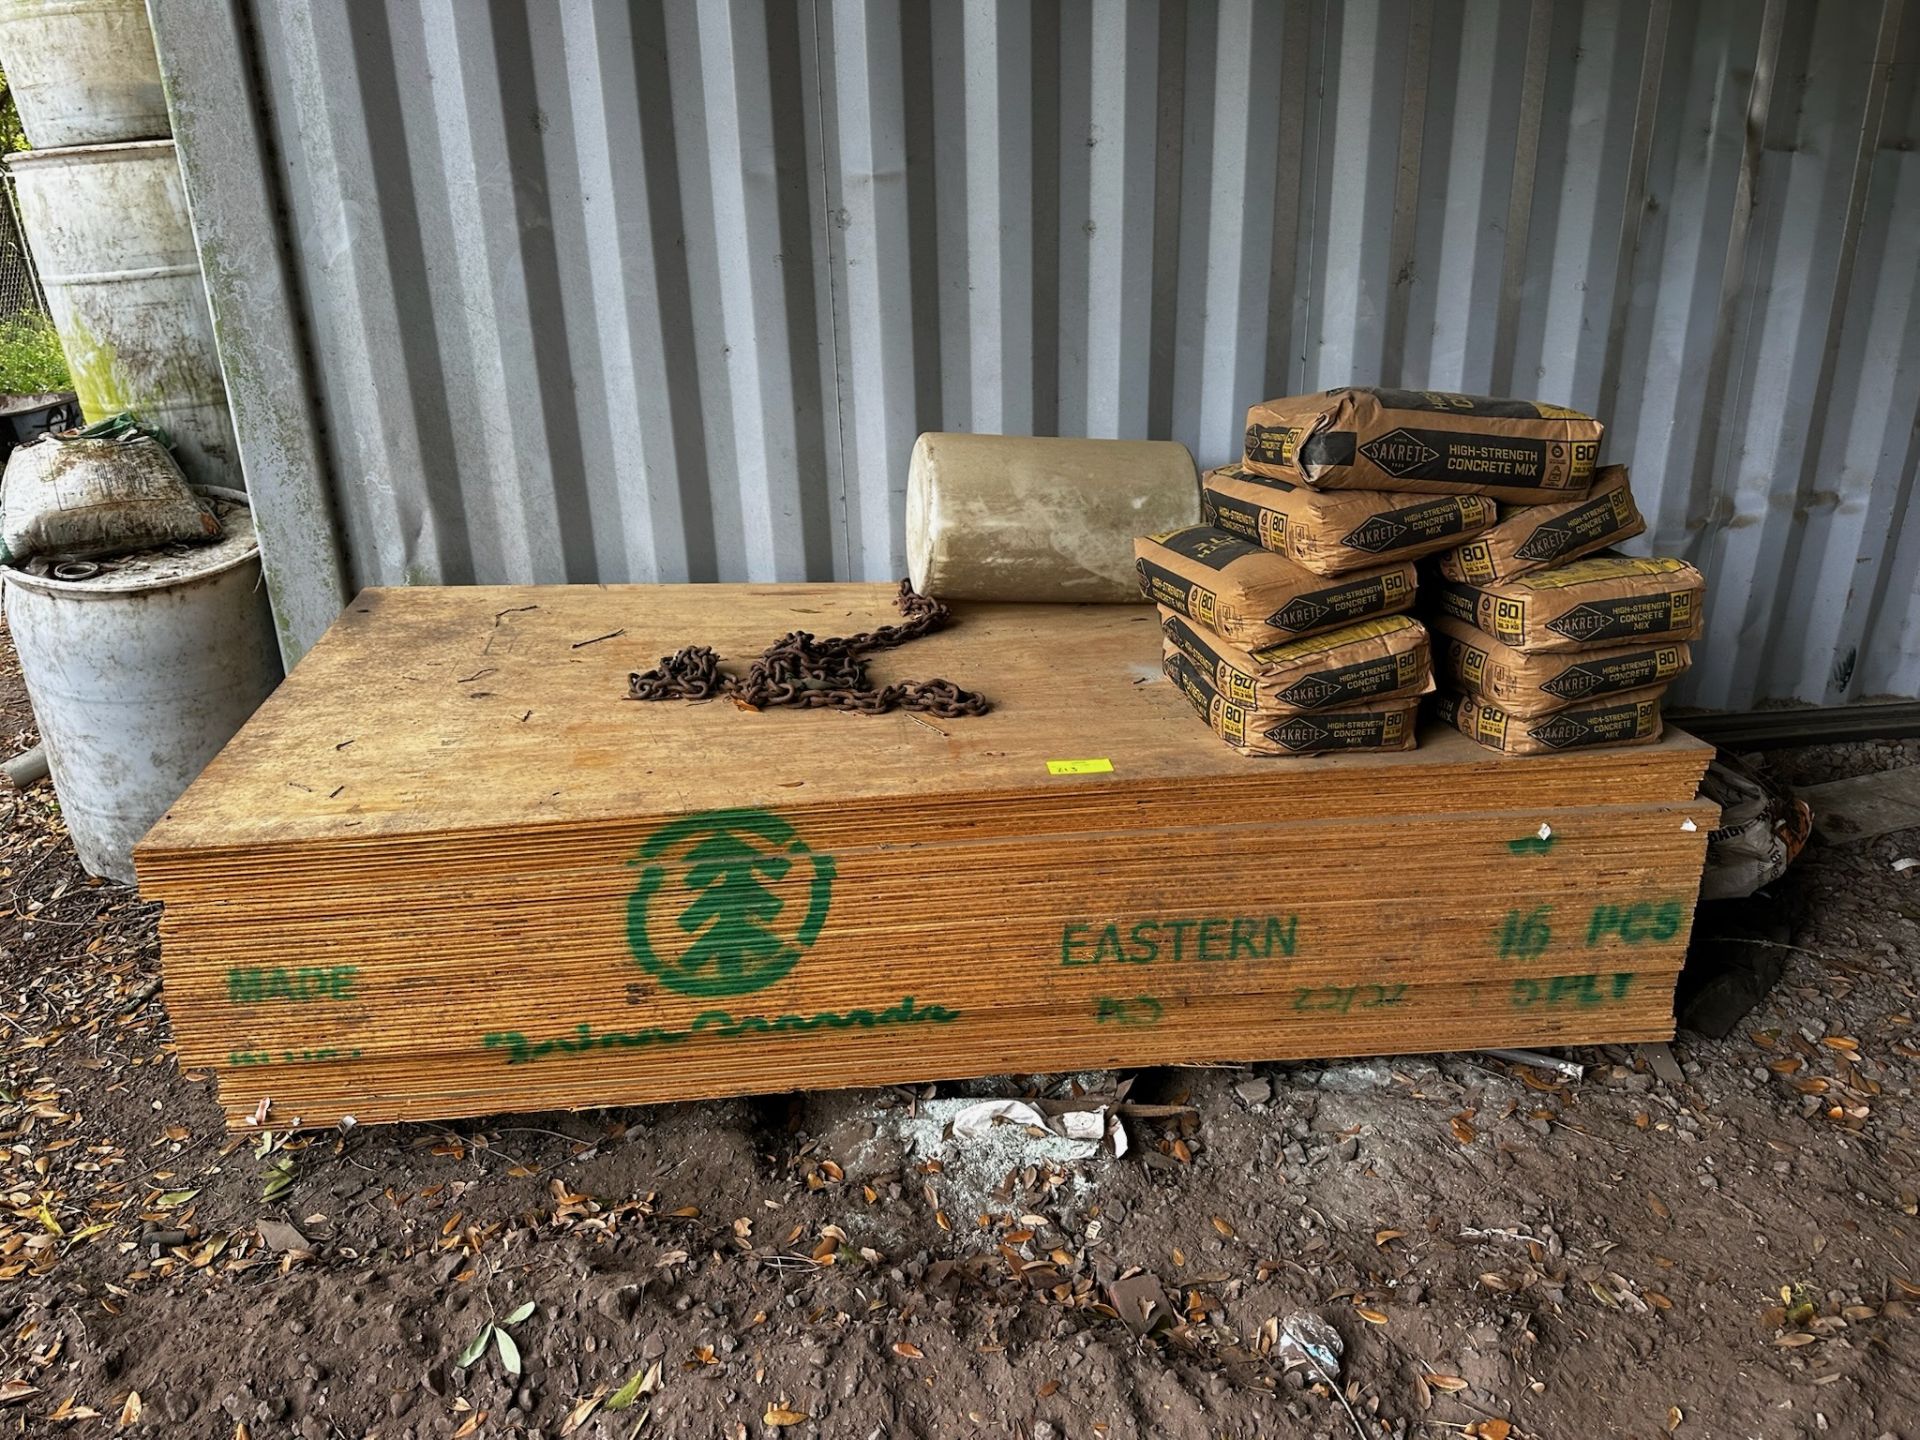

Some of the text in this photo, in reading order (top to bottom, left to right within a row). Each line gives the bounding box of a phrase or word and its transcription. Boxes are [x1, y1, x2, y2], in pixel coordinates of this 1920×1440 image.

[1370, 441, 1430, 463] SAKRETE
[1449, 444, 1538, 462] HIGH-STRENGTH
[1574, 445, 1597, 461] 80
[1447, 457, 1538, 477] CONCRETE MIX
[1460, 495, 1478, 510] 80
[1611, 493, 1625, 507] 80
[1404, 503, 1459, 523] HIGH-STRENGTH
[1568, 502, 1612, 528] HIGH-STRENGTH
[1272, 516, 1285, 533] 80
[1412, 513, 1455, 531] CONCRETE
[1425, 525, 1442, 536] MIX
[1575, 512, 1610, 534] CONCRETE
[1351, 523, 1399, 546] SAKRETE
[1523, 531, 1567, 558] SAKRETE
[1462, 545, 1485, 562] 80
[1384, 576, 1403, 591] 80
[1201, 593, 1213, 611] 80
[1326, 584, 1383, 604] HIGH-STRENGTH
[1335, 594, 1377, 611] CONCRETE
[1673, 593, 1689, 608] 80
[1498, 602, 1519, 620] 80
[1612, 600, 1671, 614] HIGH-STRENGTH
[1275, 605, 1322, 627] SAKRETE
[1555, 614, 1606, 632] SAKRETE
[1619, 610, 1664, 623] CONCRETE
[1633, 622, 1650, 631] MIX
[1399, 653, 1415, 669] 80
[1466, 651, 1483, 669] 80
[1602, 657, 1657, 674] HIGH-STRENGTH
[1658, 650, 1676, 666] 80
[1338, 663, 1396, 683] HIGH-STRENGTH
[1346, 673, 1391, 690] CONCRETE
[1608, 668, 1650, 682] CONCRETE
[1233, 674, 1253, 690] 80
[1550, 675, 1596, 693] SAKRETE
[1285, 683, 1334, 701] SAKRETE
[1225, 705, 1241, 723] 80
[1385, 713, 1401, 727] 80
[1481, 706, 1504, 722] 80
[1587, 710, 1638, 725] HIGH-STRENGTH
[1639, 705, 1653, 718] 80
[1327, 719, 1384, 730] HIGH-STRENGTH
[1333, 728, 1376, 738] CONCRETE
[1537, 726, 1582, 739] SAKRETE
[1593, 720, 1632, 733] CONCRETE
[1273, 728, 1320, 741] SAKRETE
[1496, 901, 1682, 960] 16 PCS
[1060, 914, 1299, 967] EASTERN
[228, 964, 359, 1004] MADE
